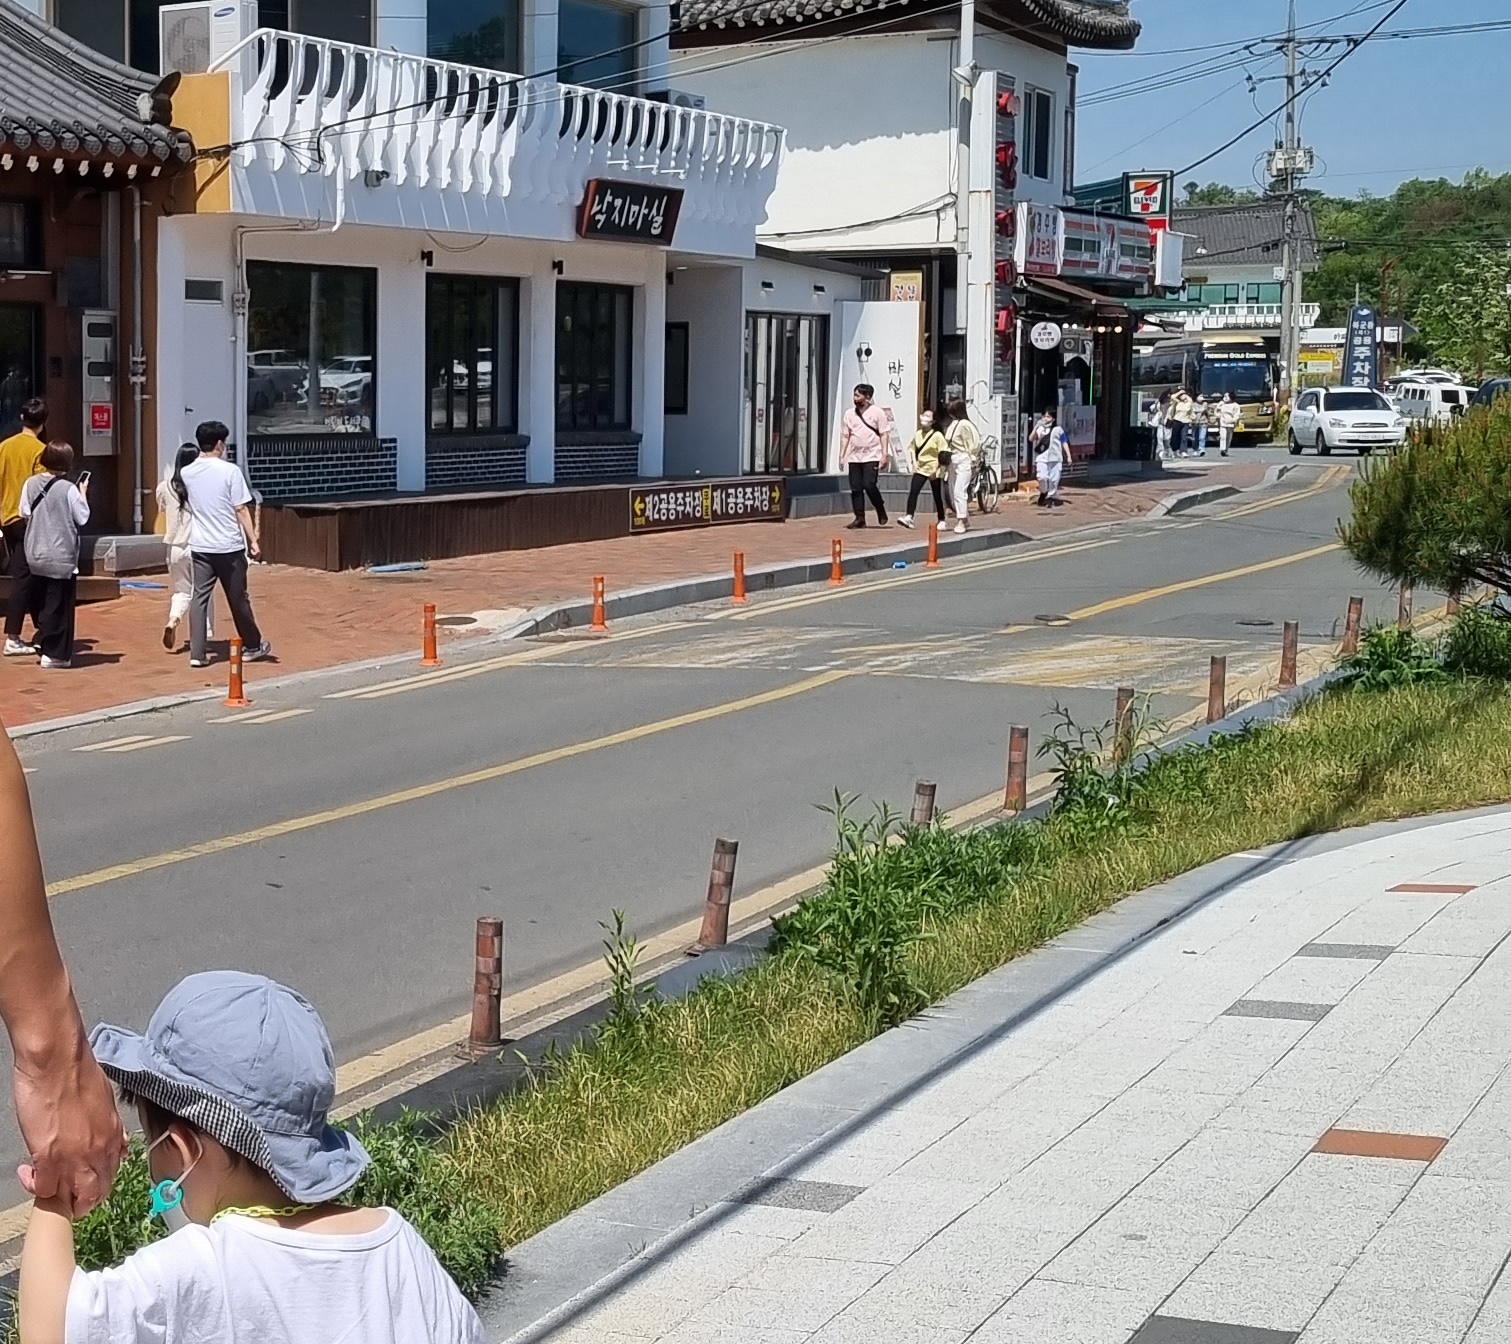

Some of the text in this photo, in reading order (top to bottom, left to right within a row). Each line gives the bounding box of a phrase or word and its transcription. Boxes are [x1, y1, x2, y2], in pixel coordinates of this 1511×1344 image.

[590, 188, 668, 235] 낙지마실
[644, 489, 703, 522] 제2공용주차장
[712, 485, 770, 516] 제1공용주차장
